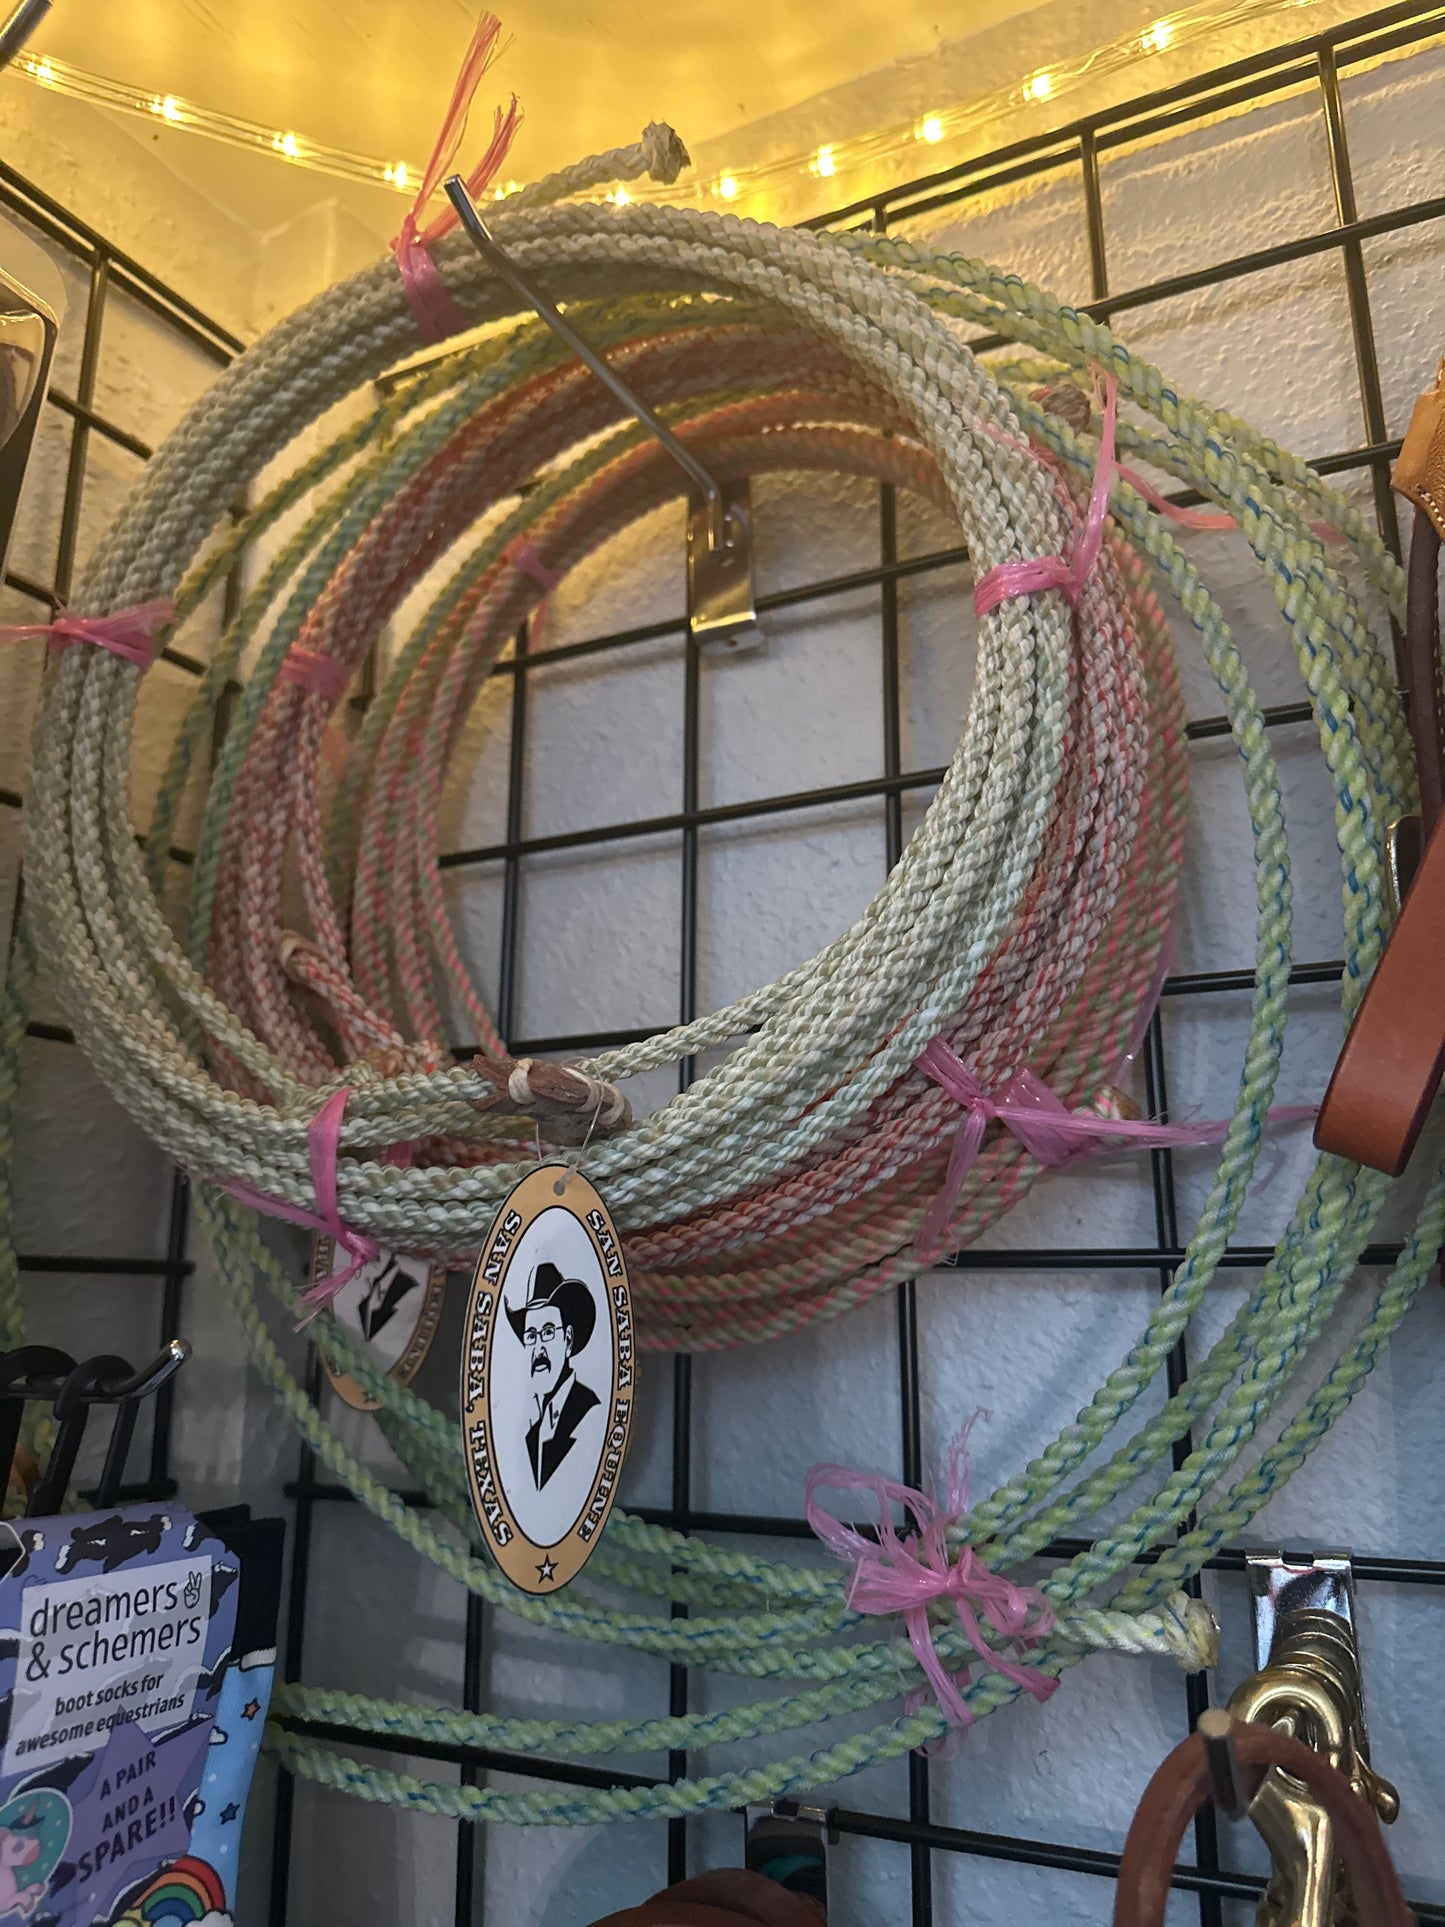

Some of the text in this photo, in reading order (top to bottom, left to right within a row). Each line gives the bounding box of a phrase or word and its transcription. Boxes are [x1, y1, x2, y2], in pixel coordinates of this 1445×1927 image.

[465, 1208, 522, 1547] SAN SABA, TEXAS
[577, 1208, 632, 1541] SAN SABA EQUINE
[30, 1581, 178, 1638] dreamers
[25, 1616, 201, 1682] & schemers
[15, 1693, 185, 1757] awesome equestrians
[55, 1673, 165, 1716] boot socks for
[100, 1751, 157, 1800] A PAIR
[78, 1795, 176, 1883] SPARE!!
[102, 1786, 154, 1833] AND A
